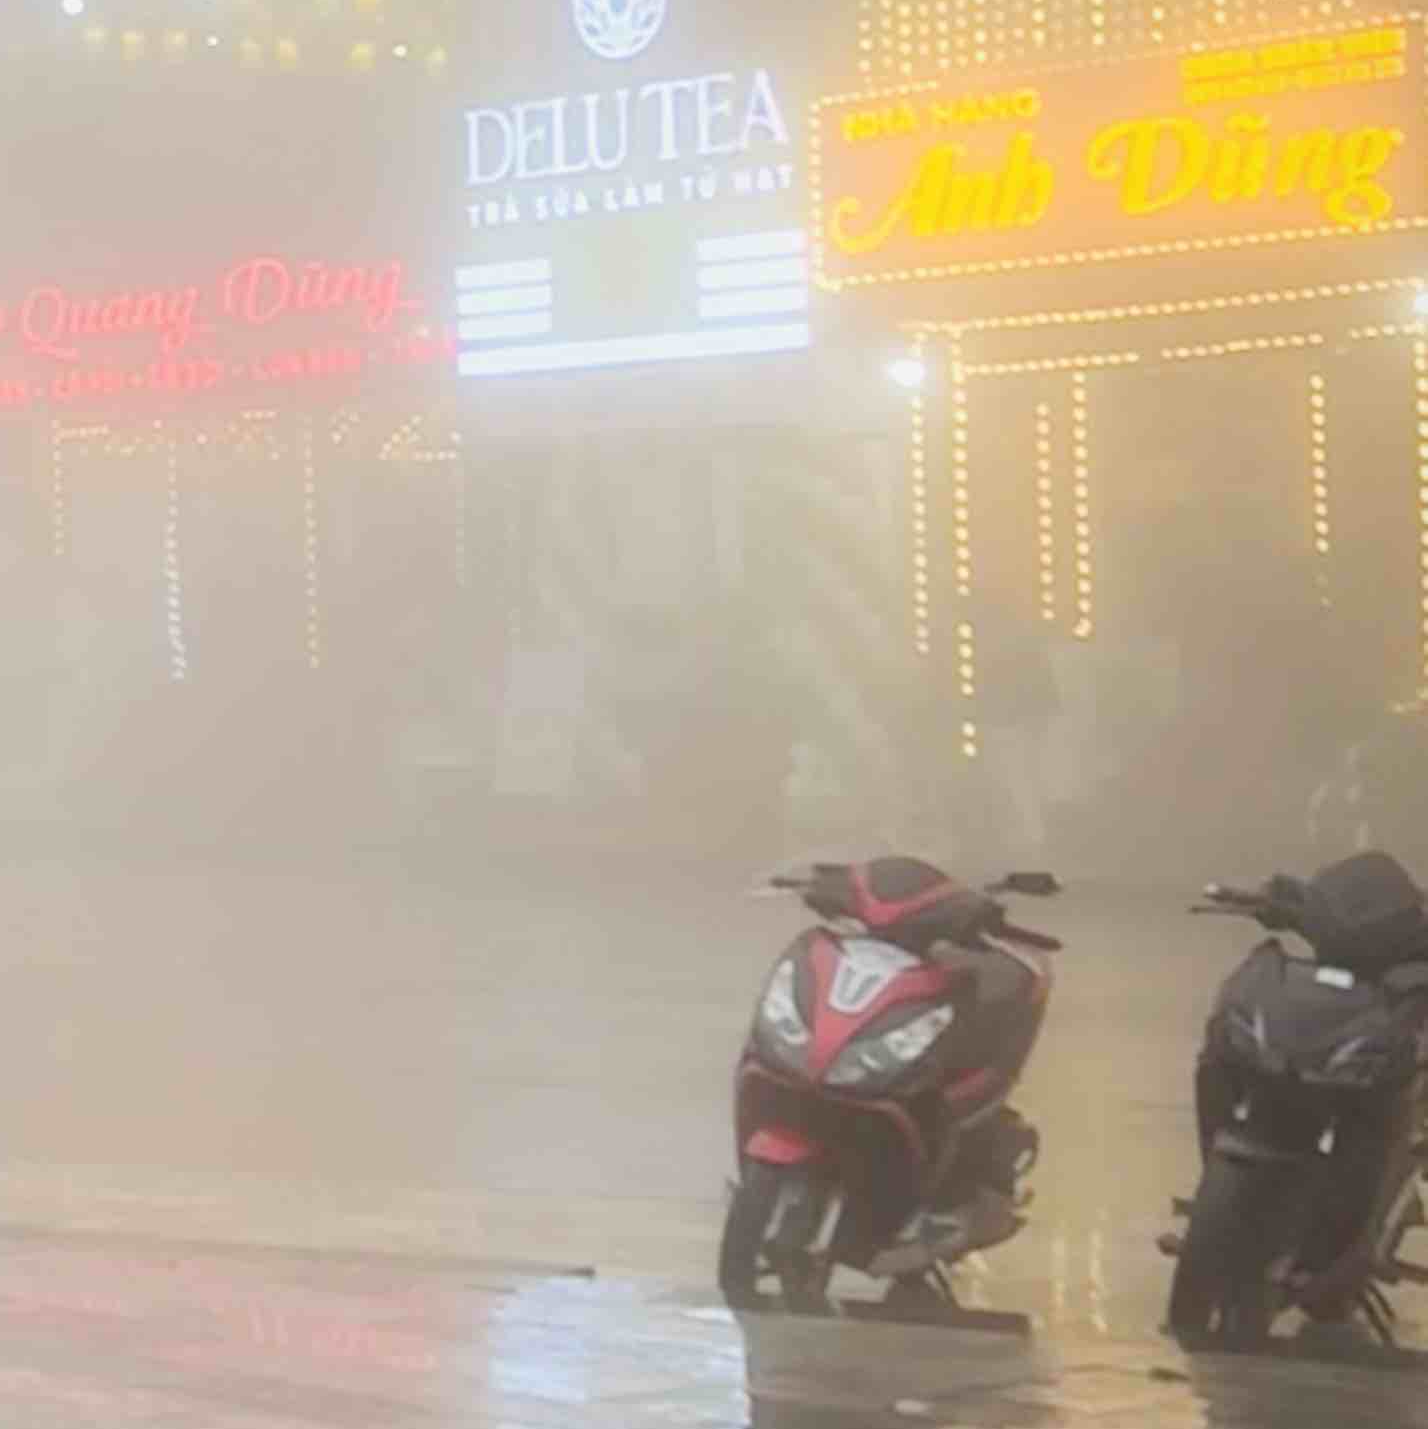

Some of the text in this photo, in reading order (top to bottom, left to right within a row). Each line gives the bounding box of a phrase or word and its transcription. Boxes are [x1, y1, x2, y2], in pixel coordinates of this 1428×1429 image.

[463, 67, 790, 186] DELU TEA
[1087, 108, 1404, 228] Dũng
[20, 284, 202, 361] Quang
[222, 255, 410, 330] Dũng
